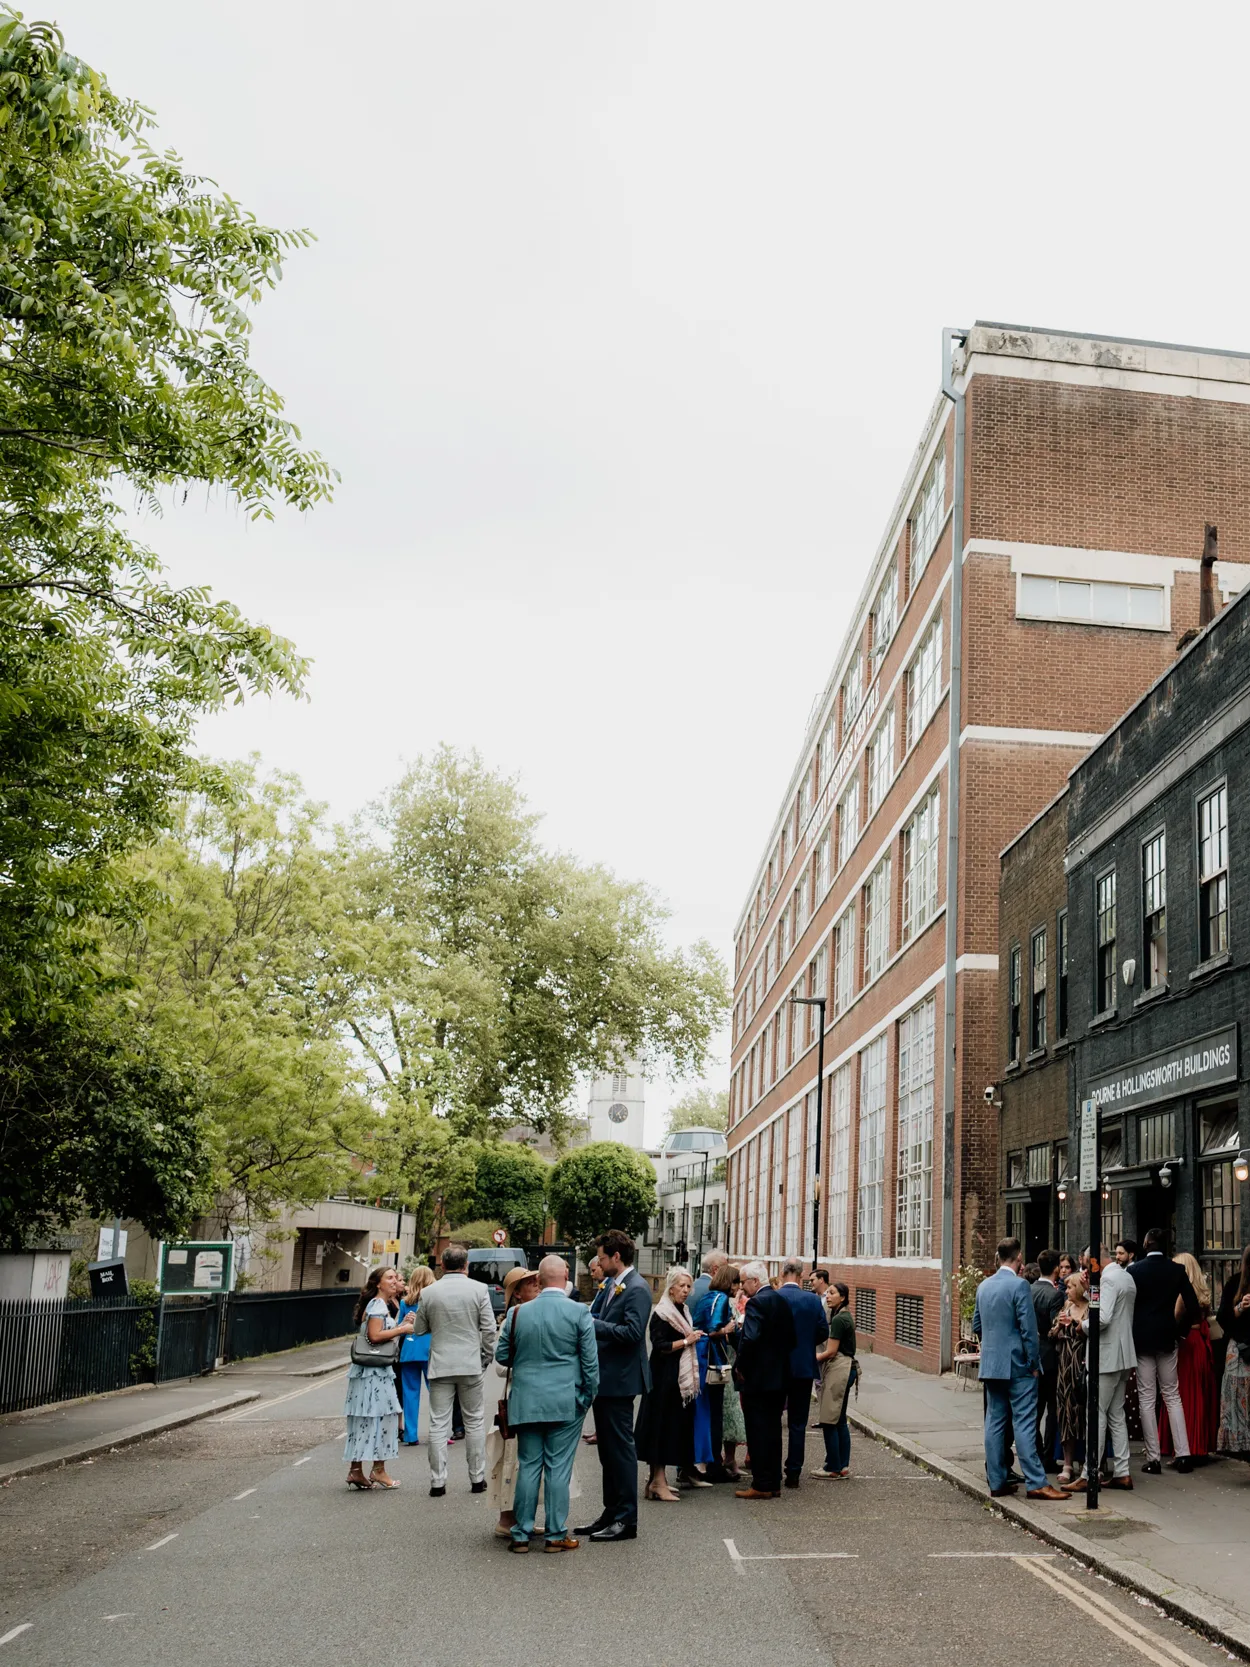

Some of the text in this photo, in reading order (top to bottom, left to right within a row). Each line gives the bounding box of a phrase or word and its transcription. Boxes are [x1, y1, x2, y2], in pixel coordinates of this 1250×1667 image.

[1116, 1081, 1122, 1099] &
[1122, 1059, 1183, 1097] HOLLINGSWORTH
[1184, 1044, 1230, 1077] BUILDINGS
